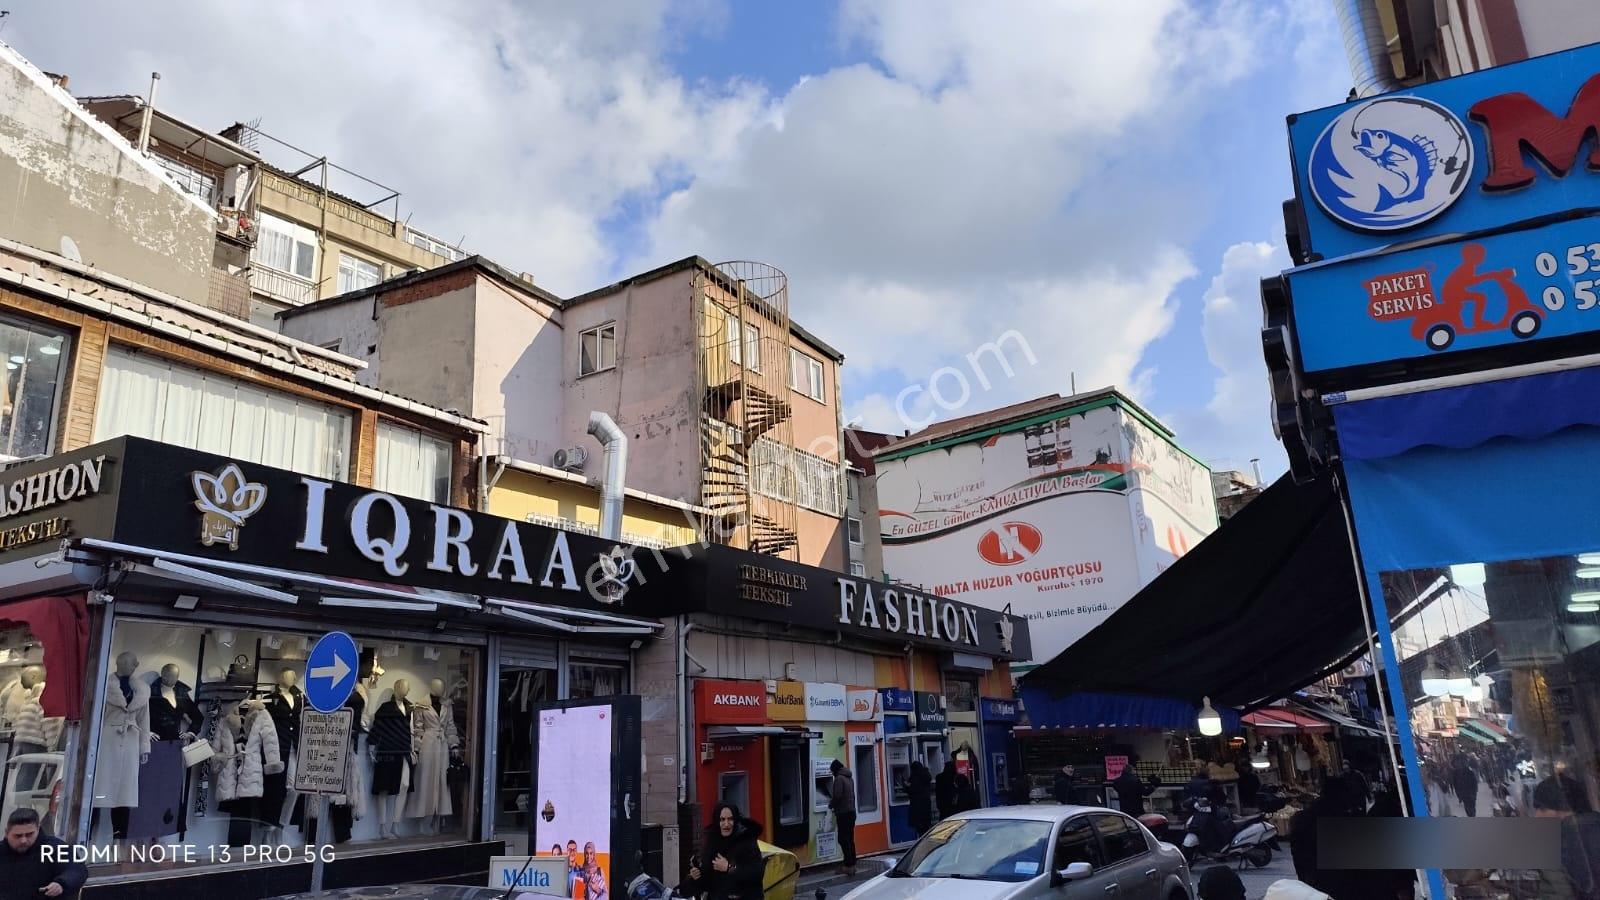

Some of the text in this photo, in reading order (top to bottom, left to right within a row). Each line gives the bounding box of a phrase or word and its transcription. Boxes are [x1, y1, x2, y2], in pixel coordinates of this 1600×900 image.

[1535, 252, 1558, 276] 0
[1370, 272, 1427, 297] PAKET
[1373, 291, 1434, 318] SERVİS
[1542, 285, 1565, 311] 0
[295, 476, 582, 592] IQRAA
[907, 517, 941, 534] GÜZEL
[934, 560, 1103, 597] MALTA HUZUR YOĞURTÇUSU
[1079, 577, 1104, 587] 1970
[836, 577, 980, 647] FASHION
[713, 693, 760, 707] AKBANK
[502, 867, 550, 887] Malta
